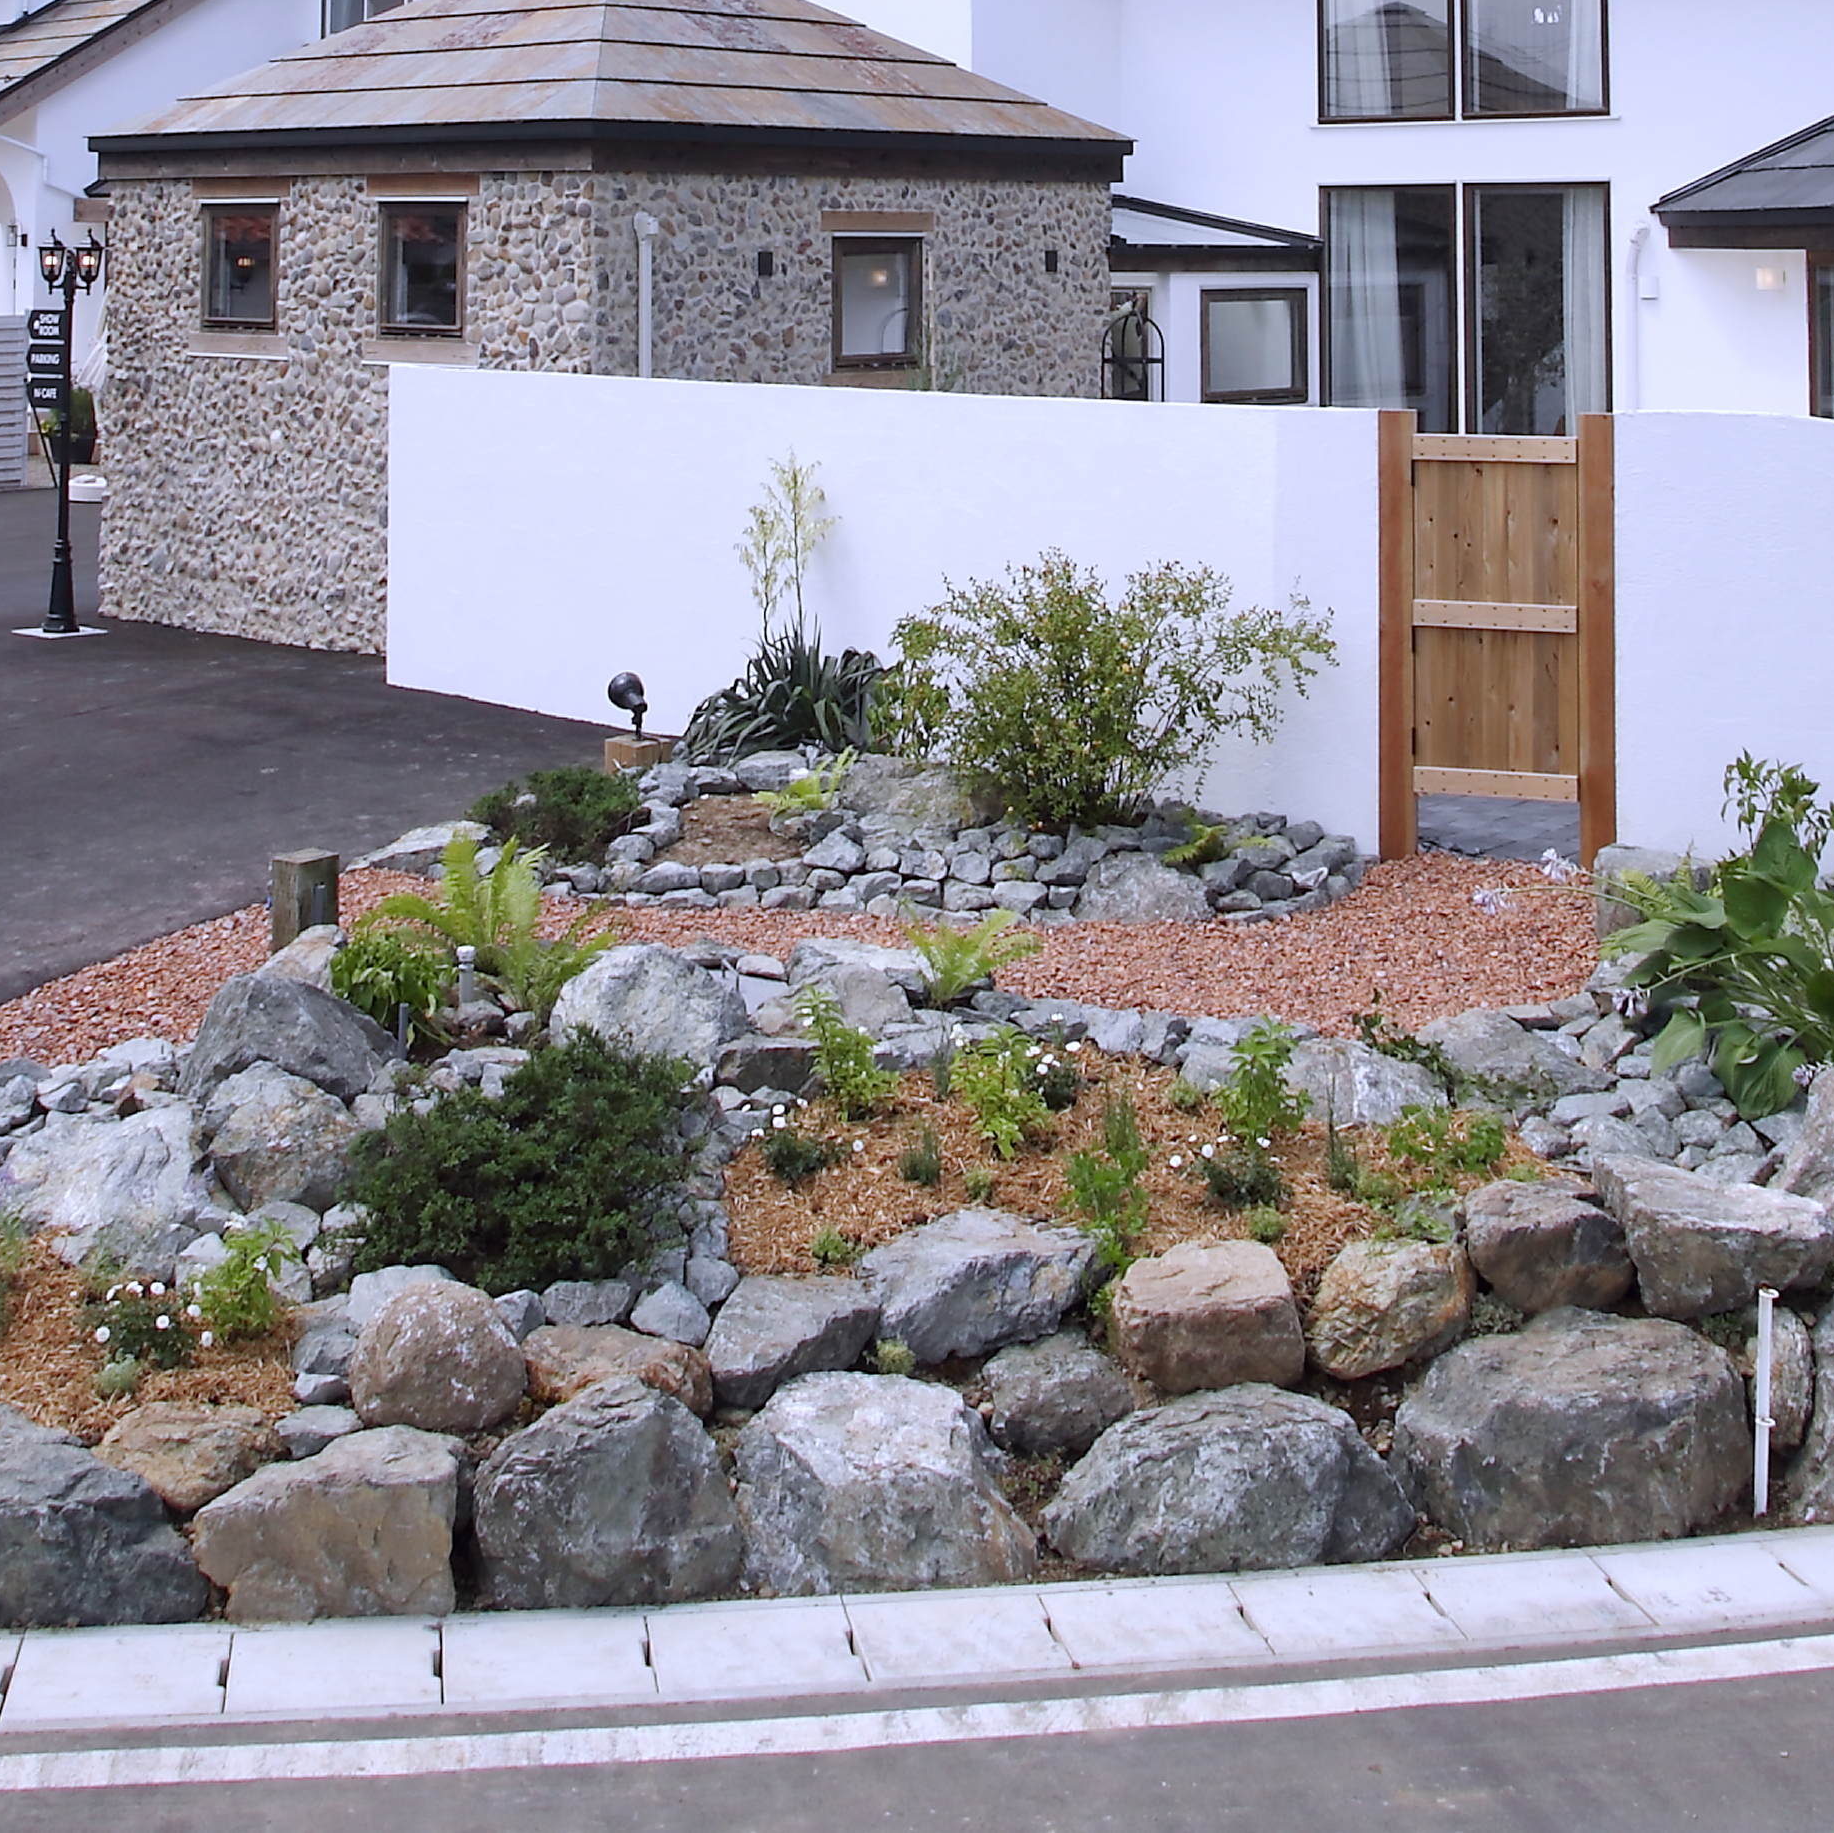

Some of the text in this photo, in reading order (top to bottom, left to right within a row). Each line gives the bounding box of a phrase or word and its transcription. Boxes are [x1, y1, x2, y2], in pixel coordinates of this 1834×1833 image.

[39, 313, 60, 324] SHOW
[39, 325, 60, 336] ROOM
[30, 353, 60, 365] PARKING
